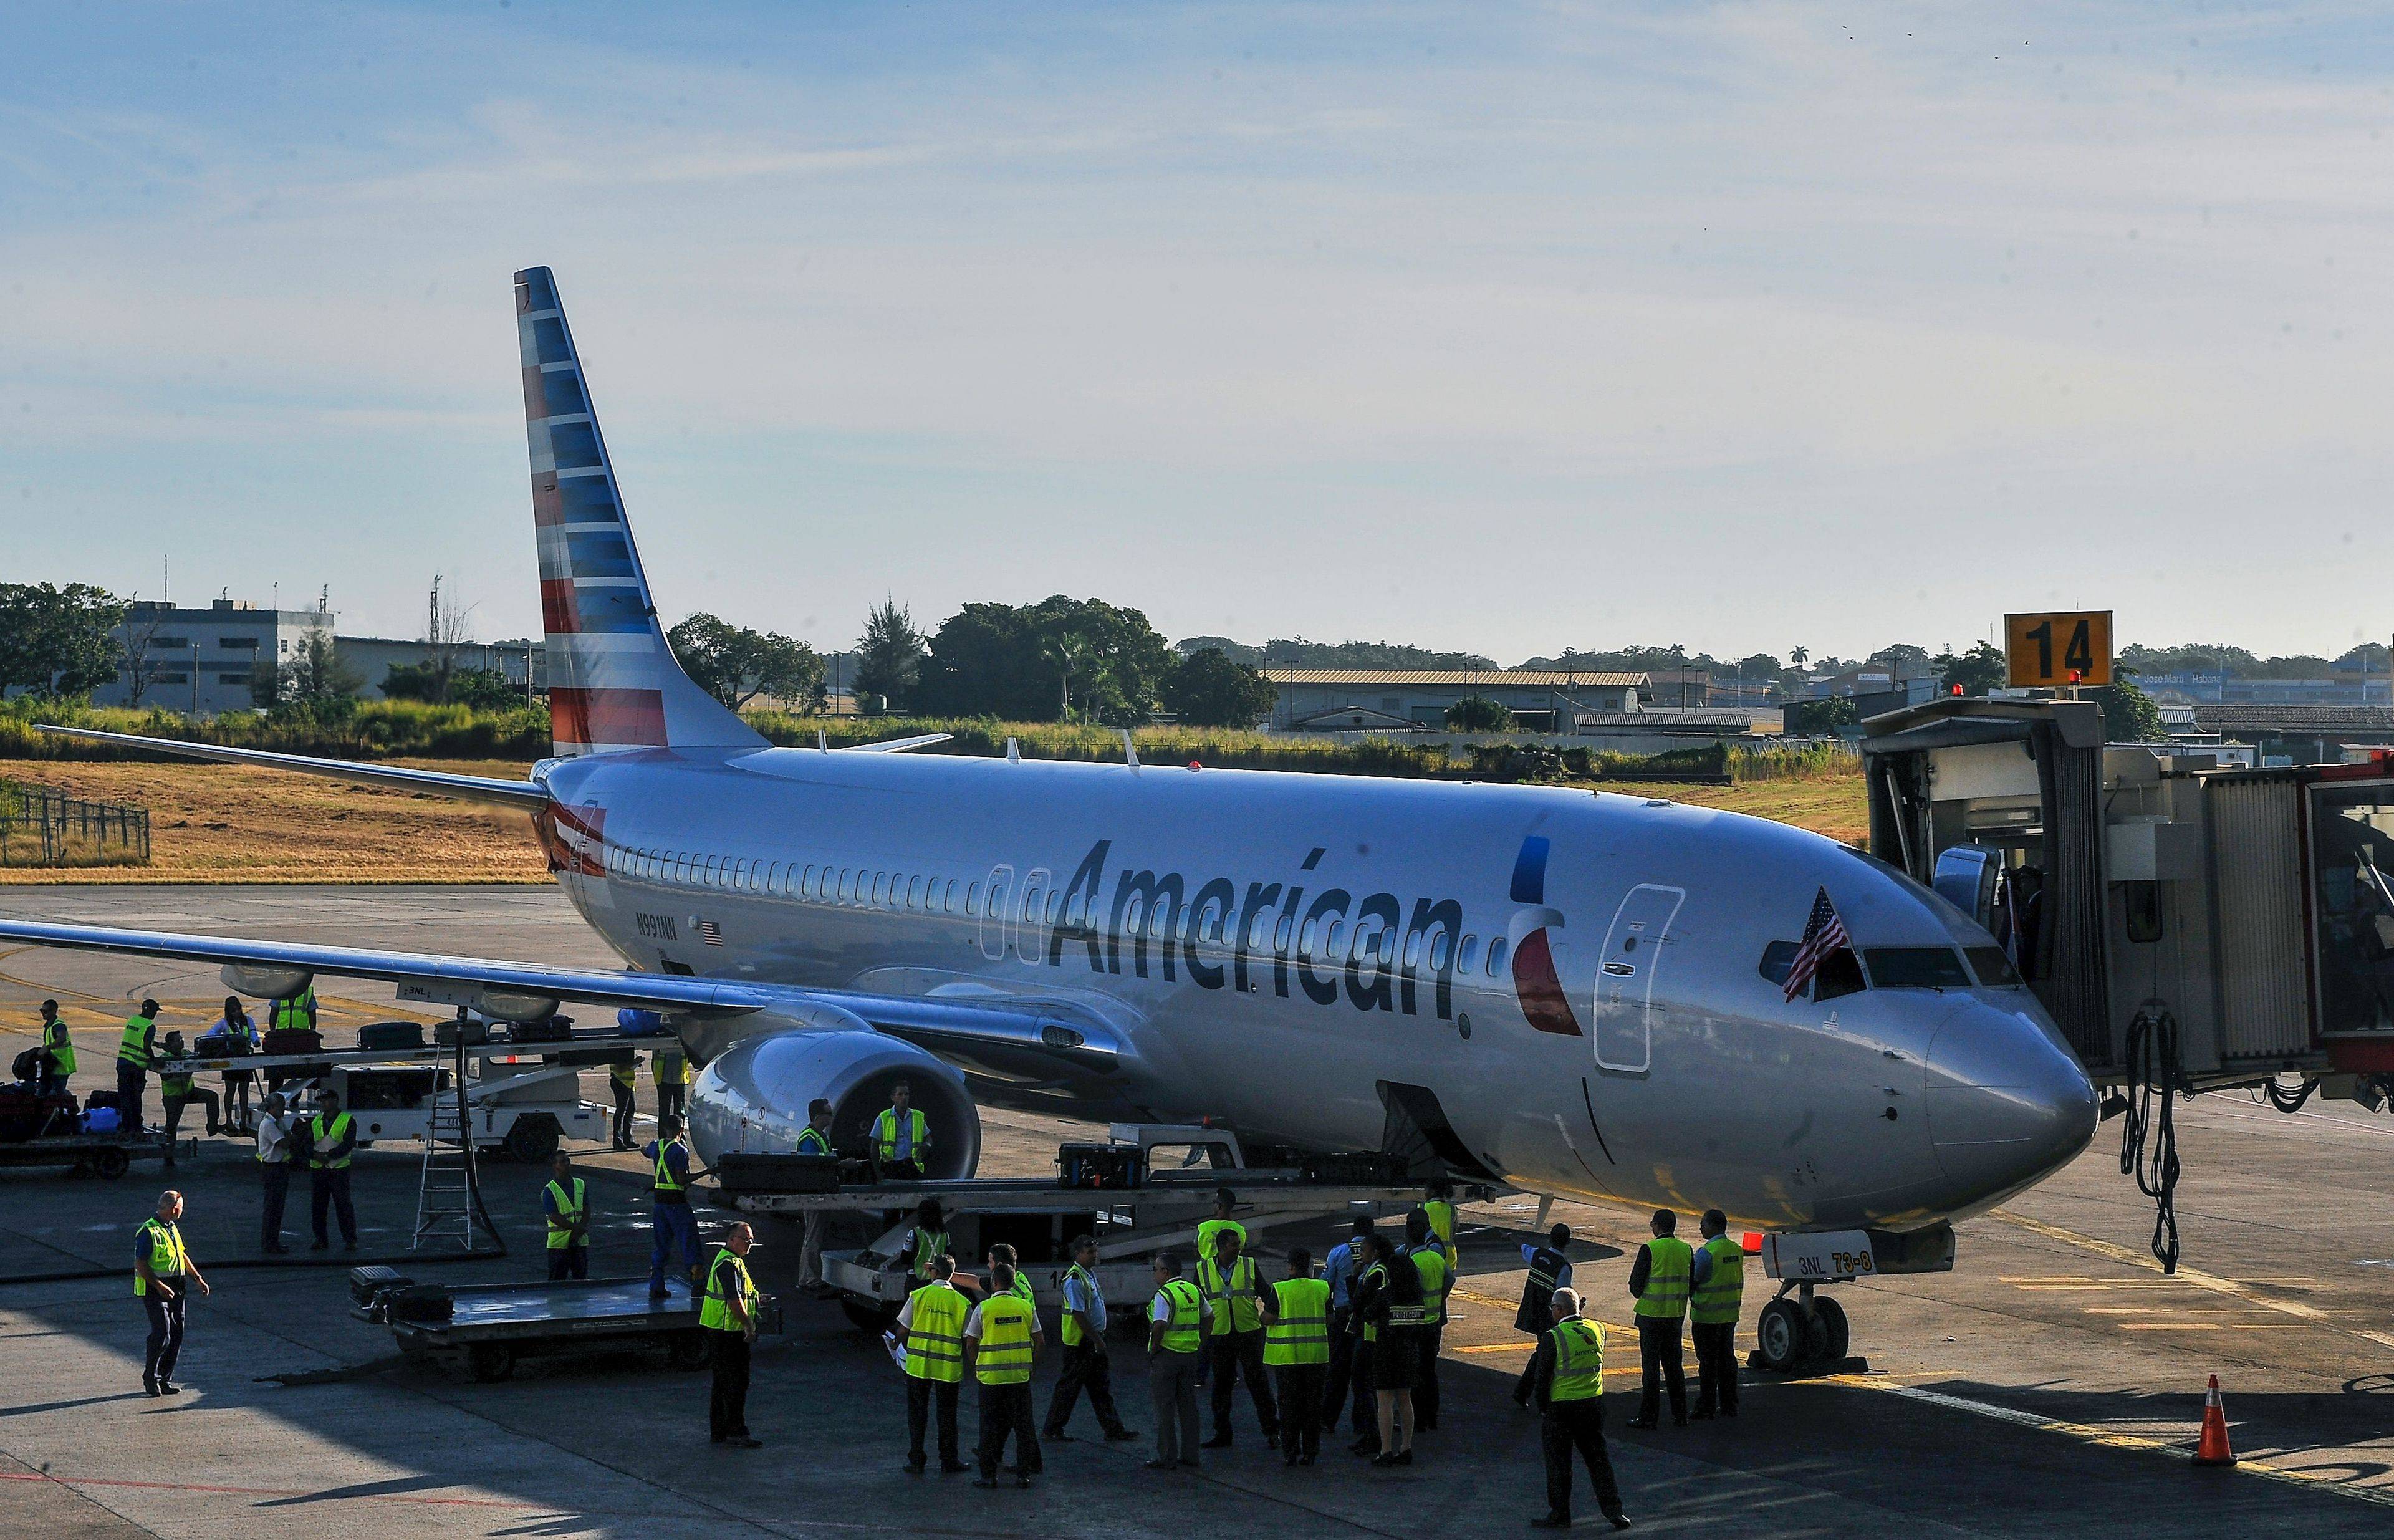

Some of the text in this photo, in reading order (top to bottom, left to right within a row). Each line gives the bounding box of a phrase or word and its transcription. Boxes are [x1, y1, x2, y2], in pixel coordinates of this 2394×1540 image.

[2026, 620, 2094, 679] 14
[636, 912, 678, 940] N991NN
[1048, 839, 1464, 1021] American
[409, 986, 426, 995] 3NL
[1799, 1250, 1872, 1276] 3NL 73-8
